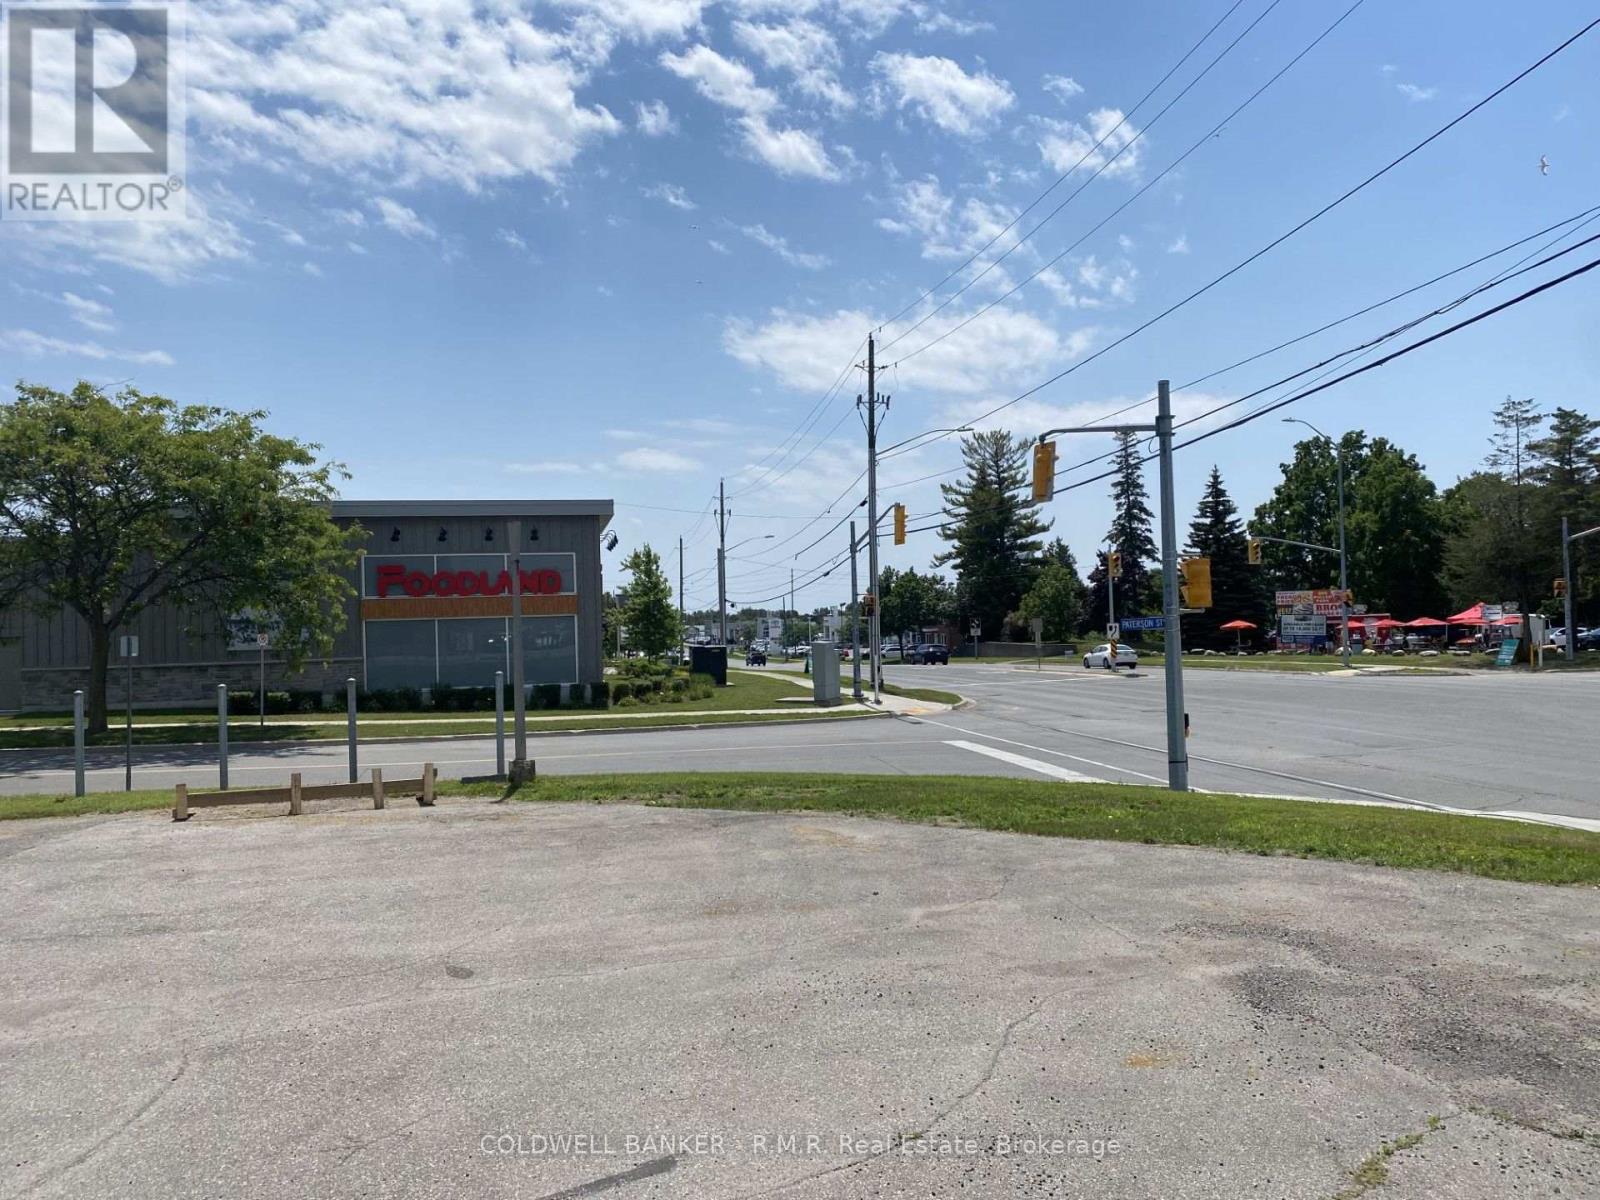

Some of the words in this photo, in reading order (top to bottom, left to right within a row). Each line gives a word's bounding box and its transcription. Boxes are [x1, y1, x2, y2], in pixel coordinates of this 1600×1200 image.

[375, 564, 562, 598] FOODLAND
[1122, 620, 1153, 629] PATERSON
[1156, 619, 1163, 627] ST
